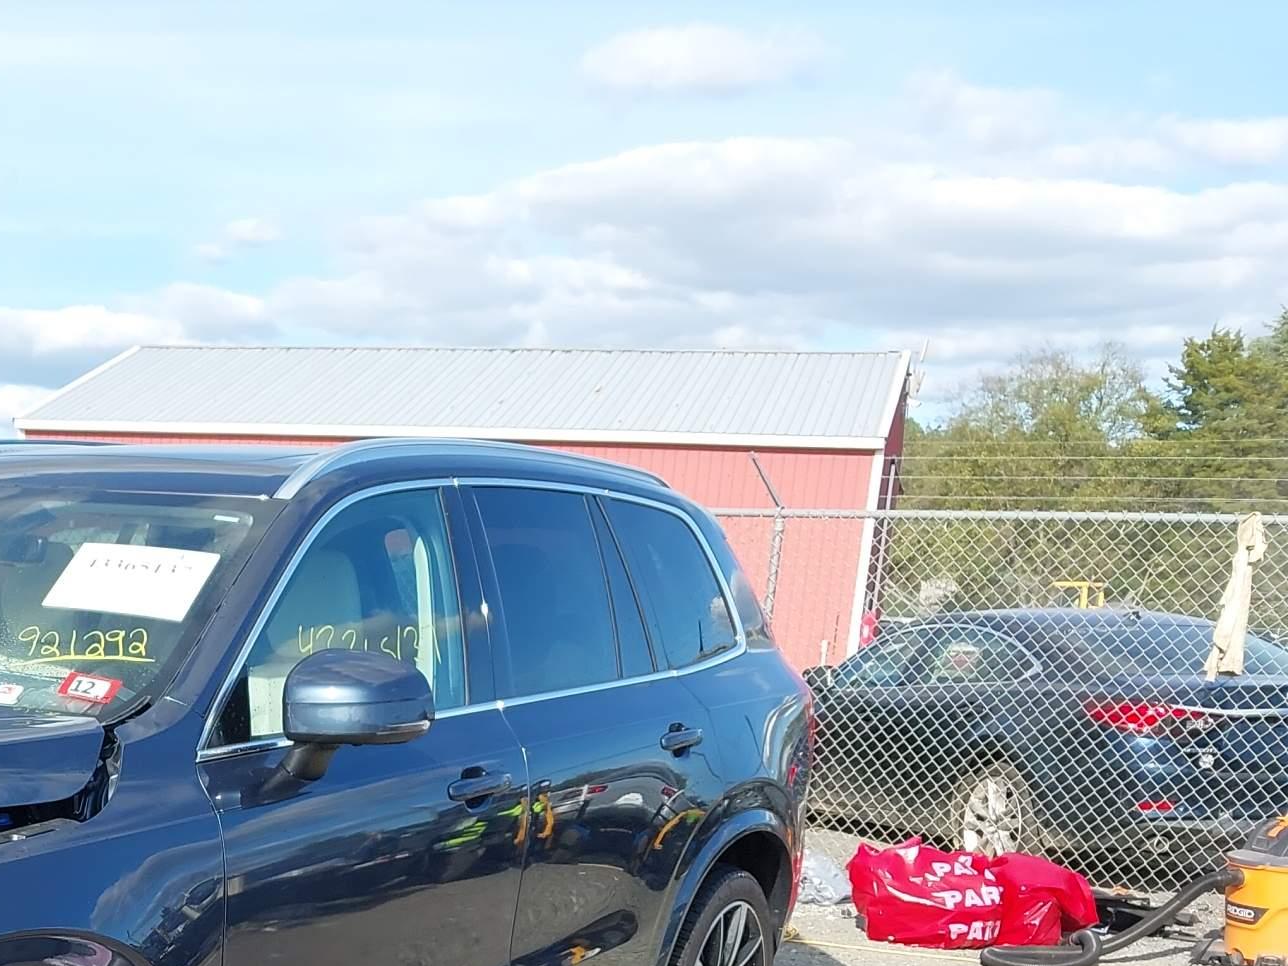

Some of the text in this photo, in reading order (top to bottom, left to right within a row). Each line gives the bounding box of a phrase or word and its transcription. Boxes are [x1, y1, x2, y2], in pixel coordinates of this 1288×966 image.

[18, 626, 148, 657] 921292
[70, 680, 96, 695] 12
[934, 886, 1004, 909] PAR
